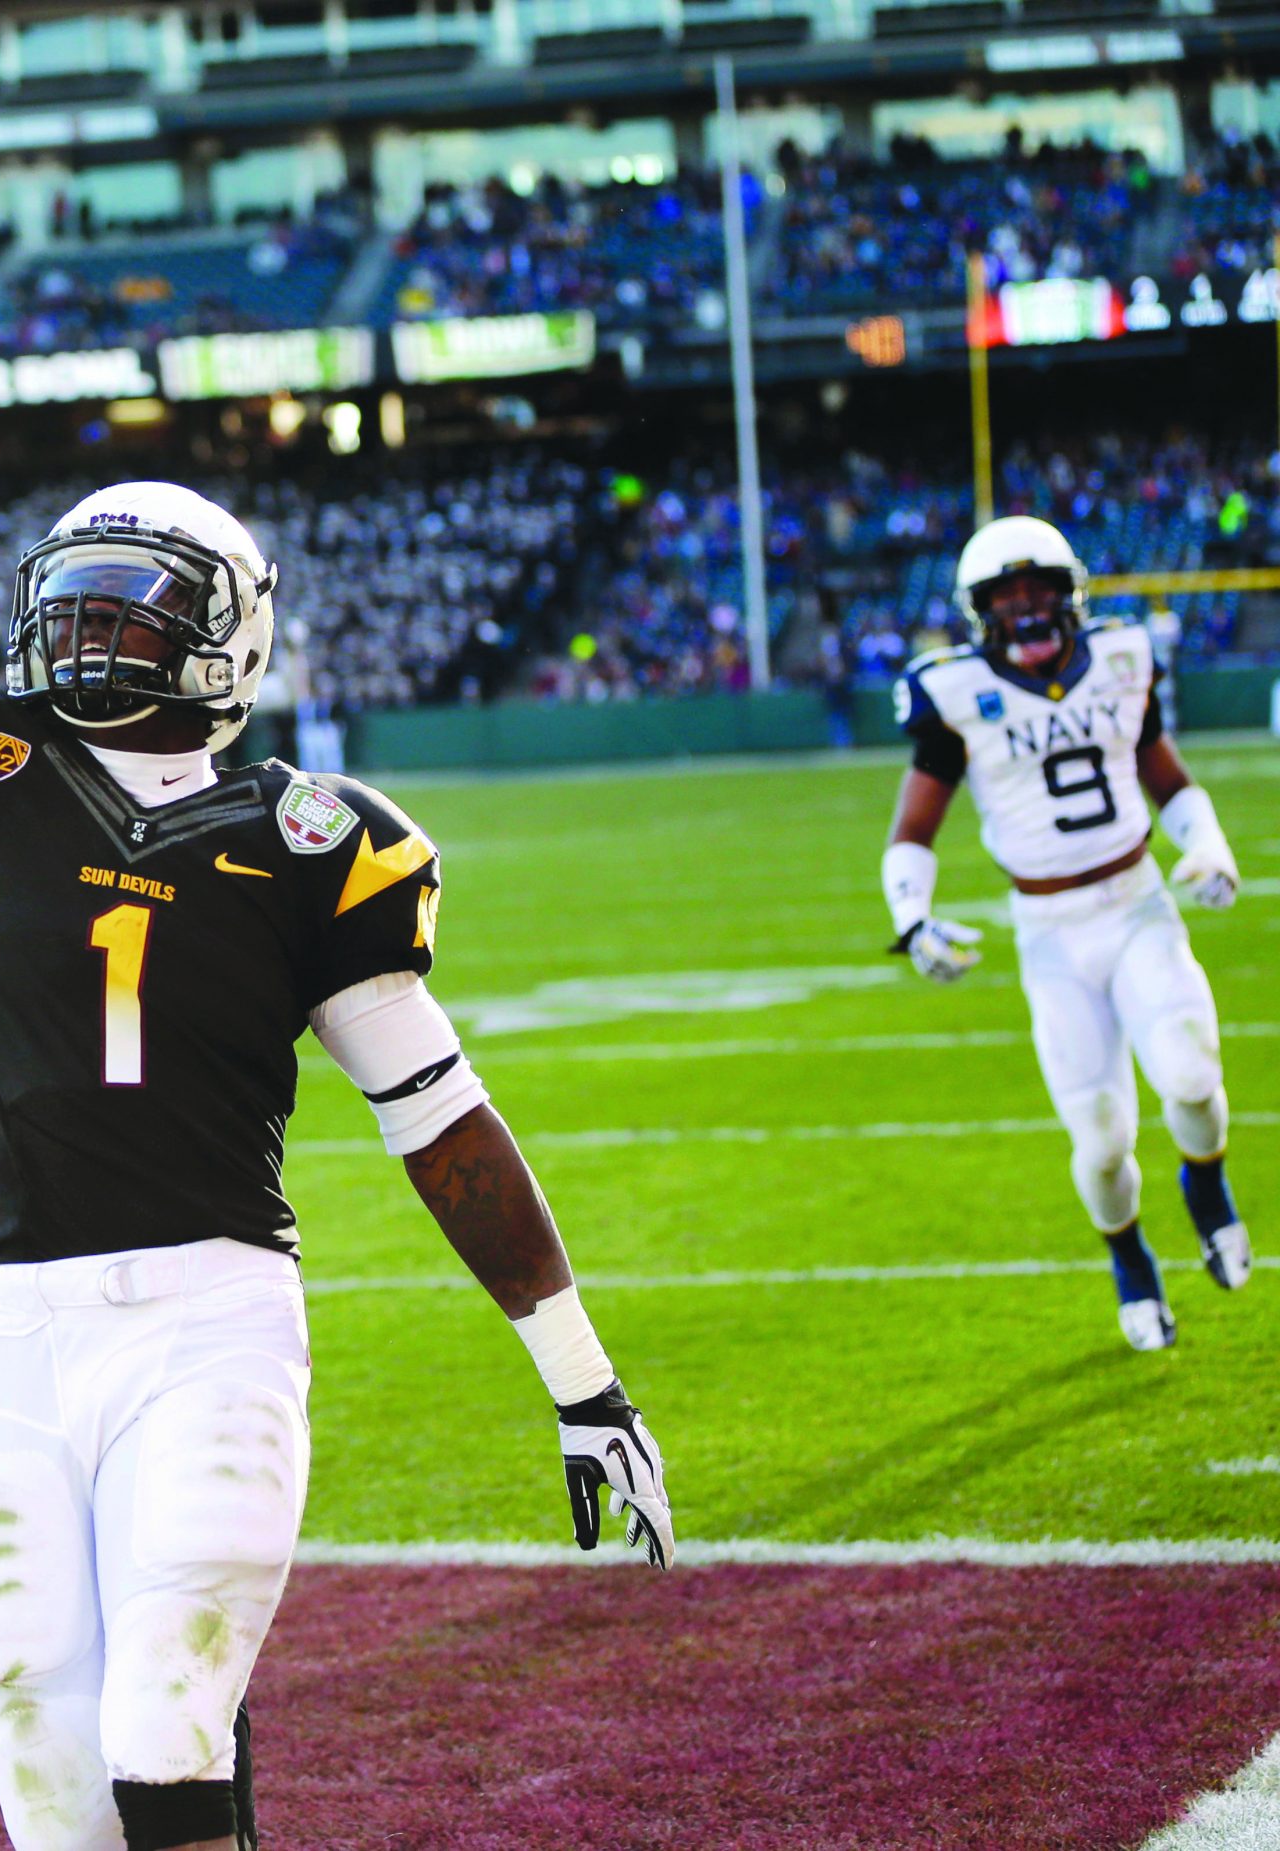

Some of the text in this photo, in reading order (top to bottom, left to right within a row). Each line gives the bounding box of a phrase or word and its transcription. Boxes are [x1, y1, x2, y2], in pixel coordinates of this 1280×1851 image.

[1006, 701, 1123, 760] NAVY
[1043, 745, 1117, 833] 9
[133, 821, 148, 831] PT
[295, 806, 330, 829] BOWL
[130, 832, 145, 842] 42
[78, 866, 176, 902] SUN DEVILS
[86, 902, 155, 1087] 1
